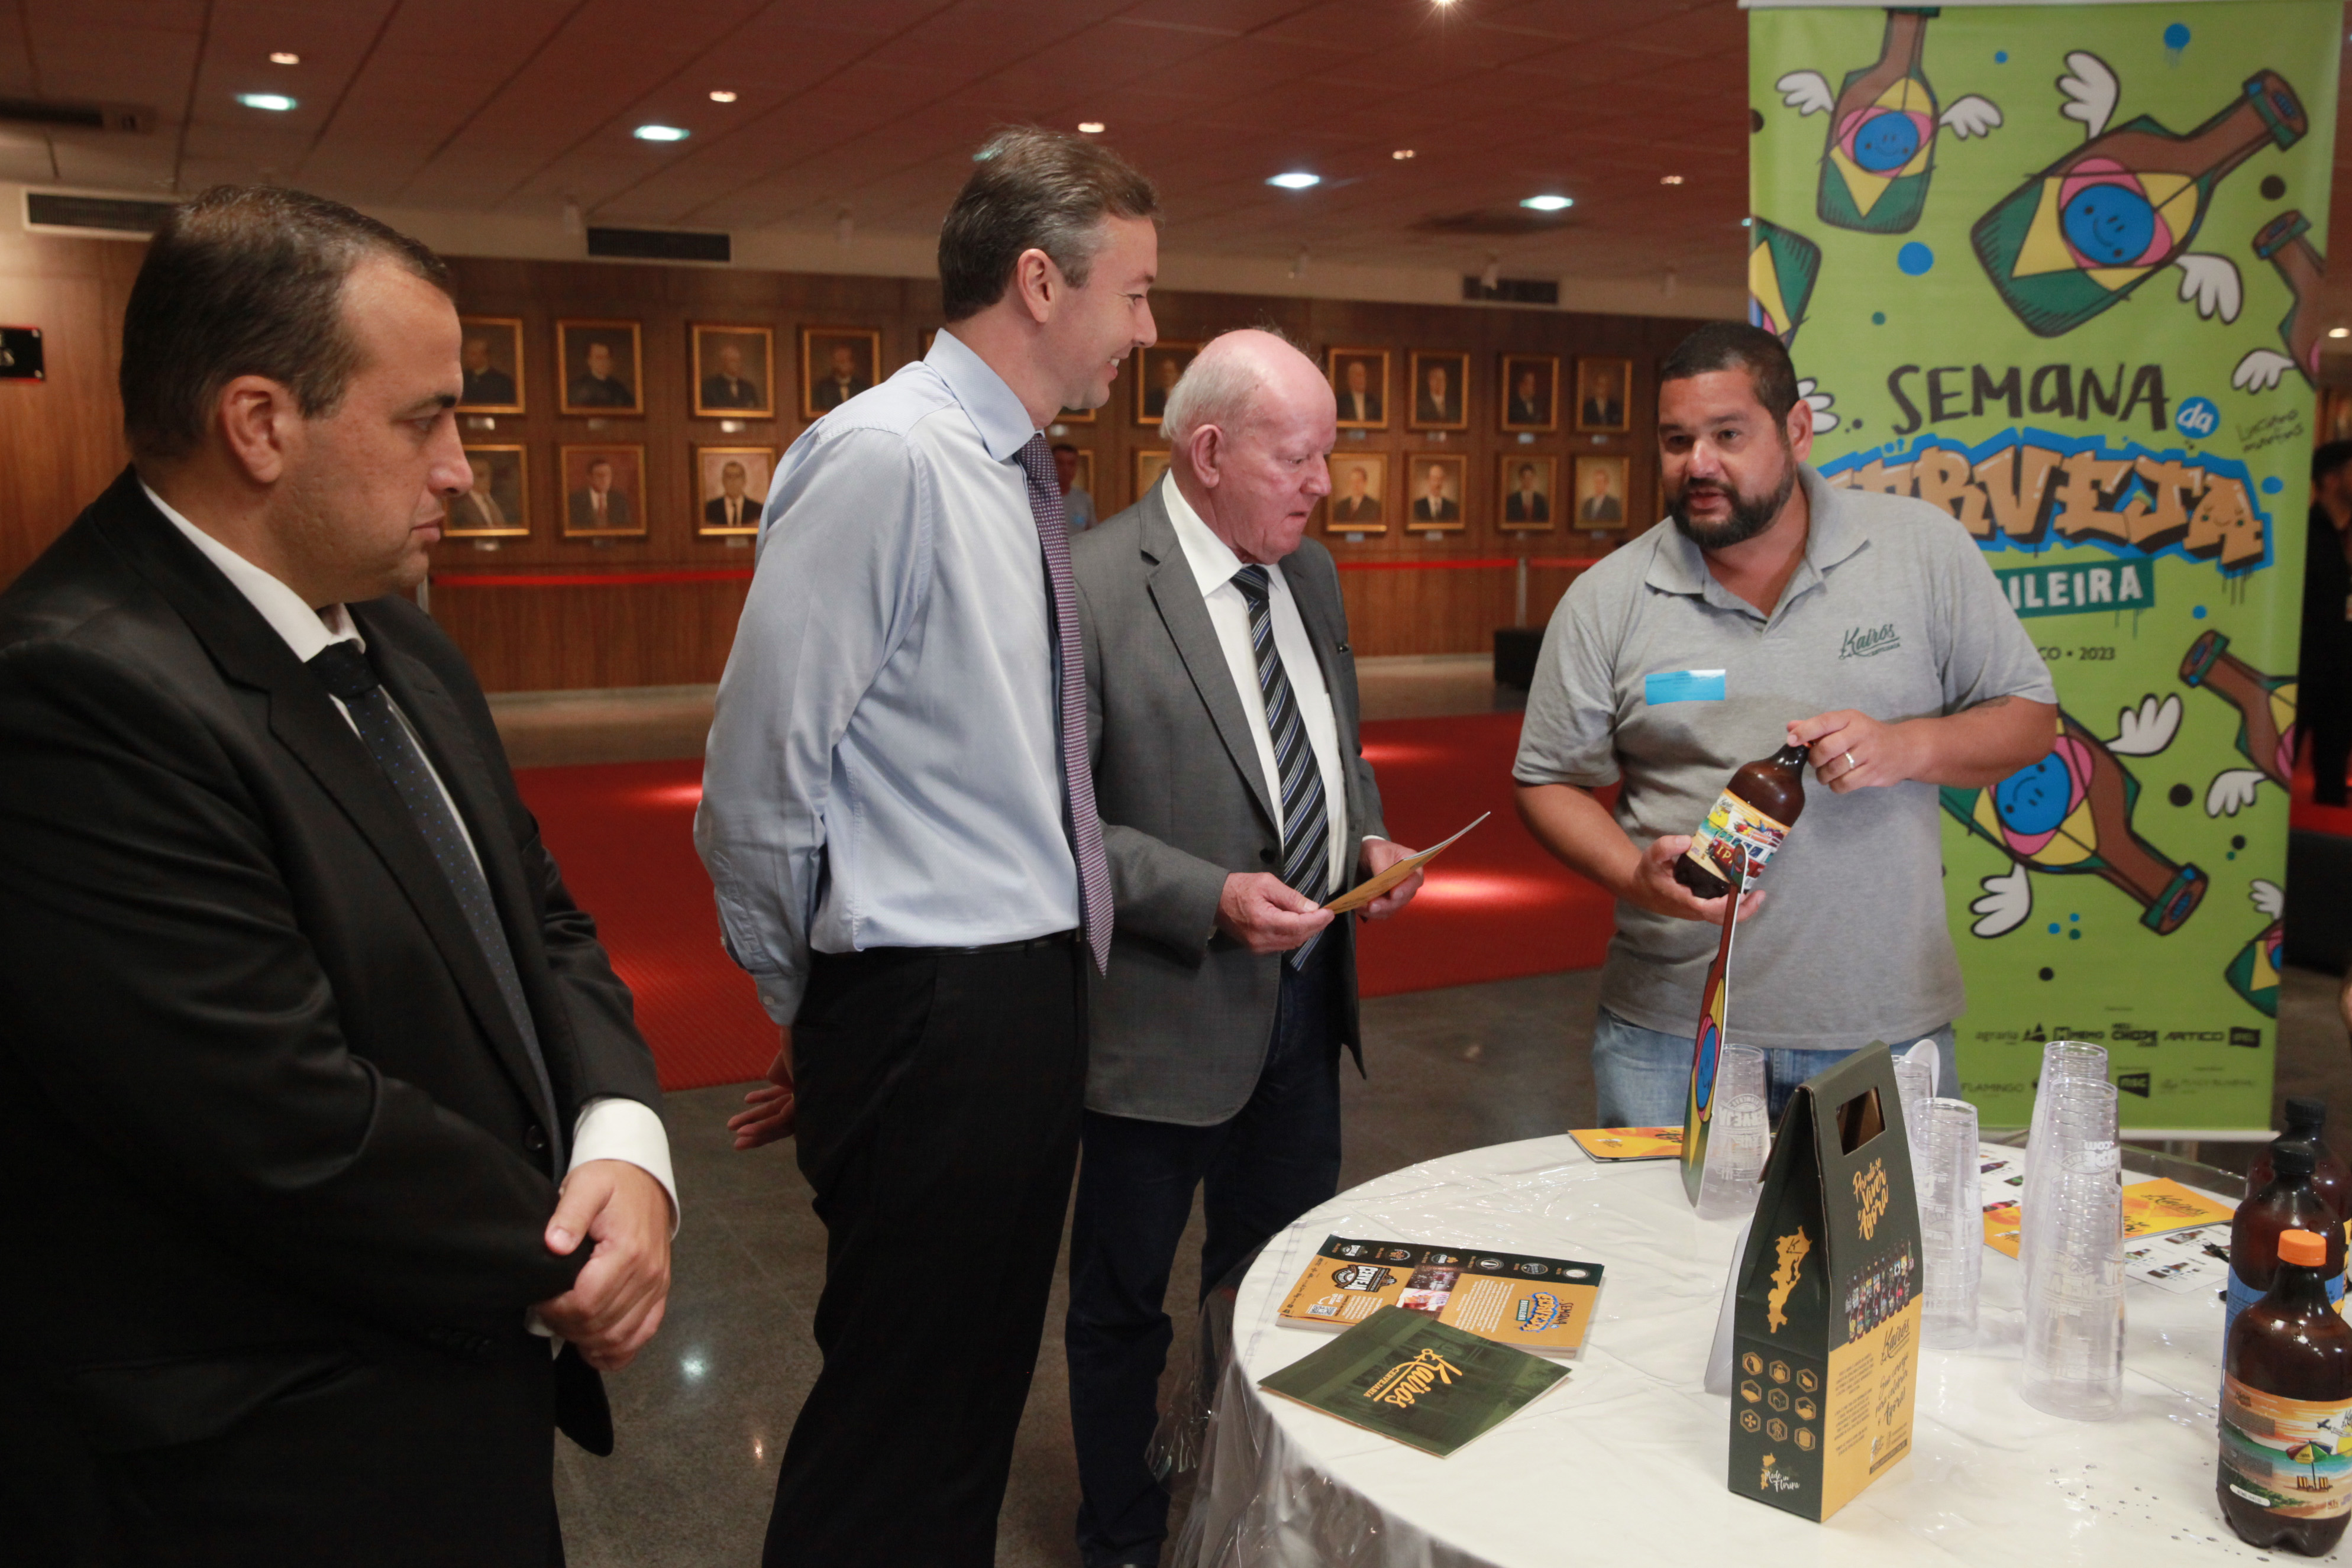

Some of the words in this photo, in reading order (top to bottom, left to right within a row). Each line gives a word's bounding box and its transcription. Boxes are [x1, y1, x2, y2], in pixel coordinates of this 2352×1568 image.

[1886, 364, 2170, 435] SEMANA
[2177, 402, 2214, 434] da
[1819, 444, 2266, 571] RVEJA
[2008, 564, 2144, 610] ILEIRA
[1858, 1184, 1889, 1240] Agora
[1861, 1168, 1886, 1213] Viver
[1343, 1265, 1379, 1291] CERVEJA
[1552, 1302, 1574, 1325] SEMANA
[1881, 1318, 1910, 1364] Kairós
[1363, 1367, 1400, 1398] CERVEJARIA
[1384, 1349, 1463, 1408] Kairós
[1765, 1470, 1782, 1483] Made
[1772, 1479, 1800, 1492] Floripa
